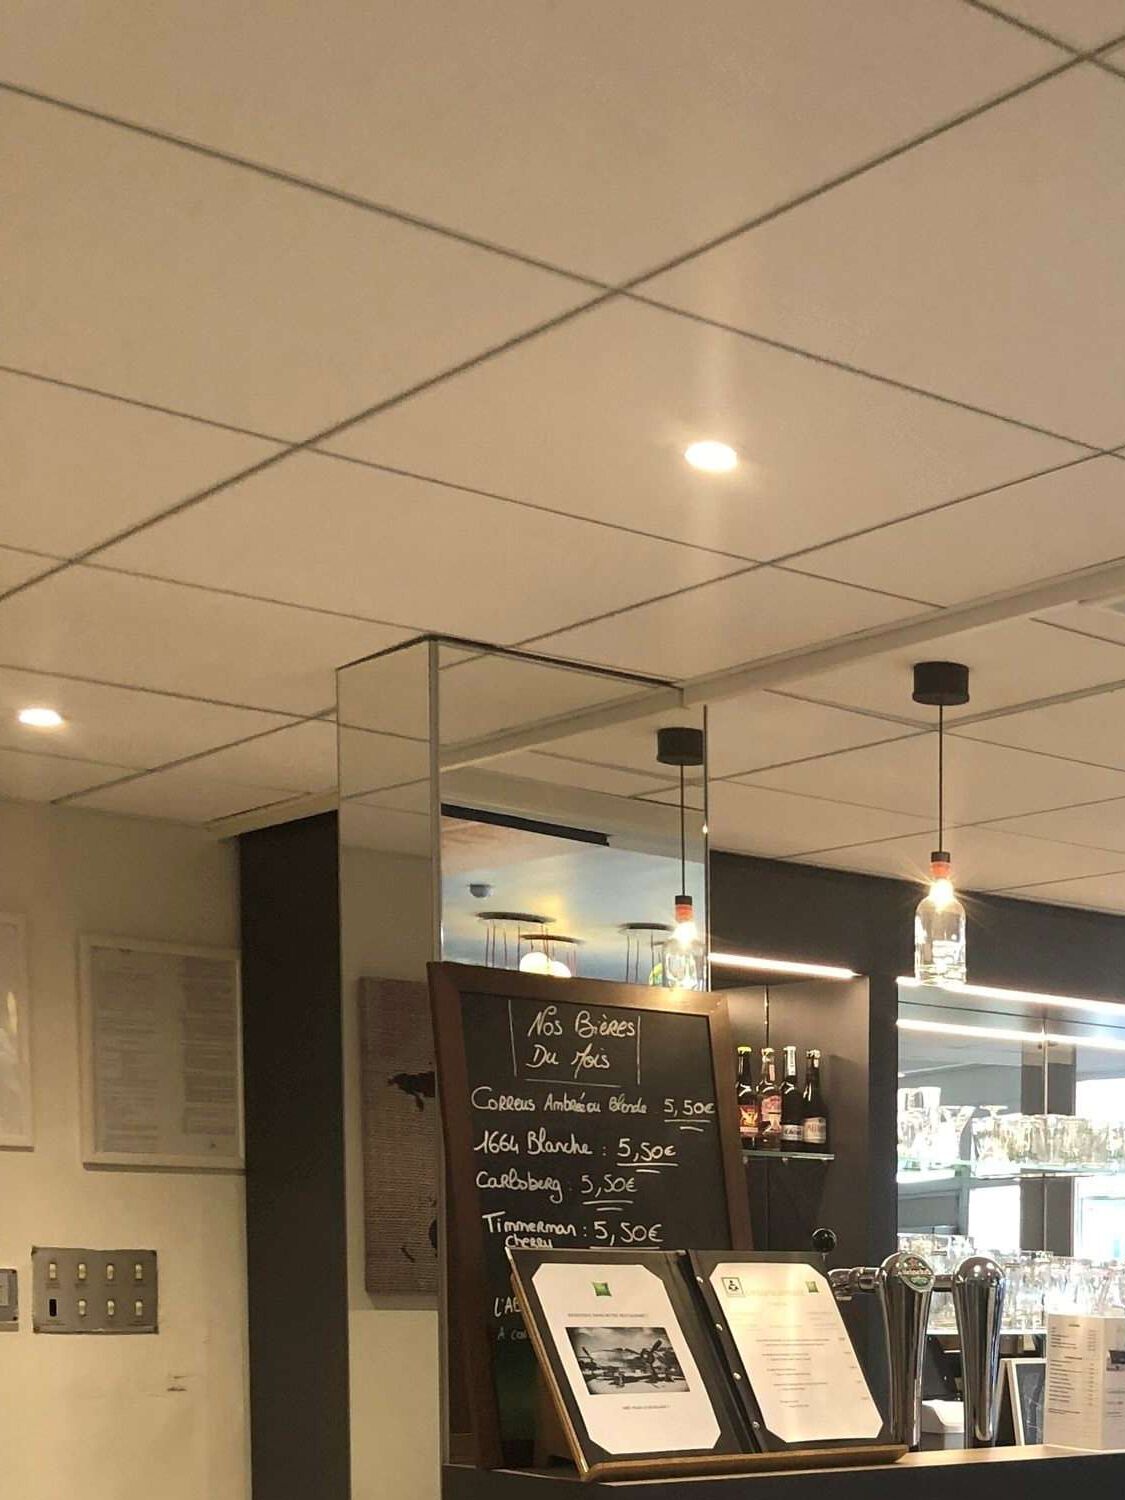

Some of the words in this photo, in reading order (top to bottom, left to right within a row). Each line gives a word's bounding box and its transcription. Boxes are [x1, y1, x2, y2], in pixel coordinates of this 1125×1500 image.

[527, 1005, 563, 1037] Nos
[575, 1010, 636, 1039] Bières
[525, 1044, 559, 1068] Du
[571, 1043, 610, 1079] Mois
[608, 1093, 648, 1114] Blonde
[473, 1130, 520, 1155] 1664
[526, 1127, 593, 1156] Blanche
[617, 1138, 677, 1162] 5,50€
[475, 1168, 563, 1205] Carlsberg
[580, 1174, 638, 1199] 5,50€
[593, 1221, 664, 1247] 5,50€
